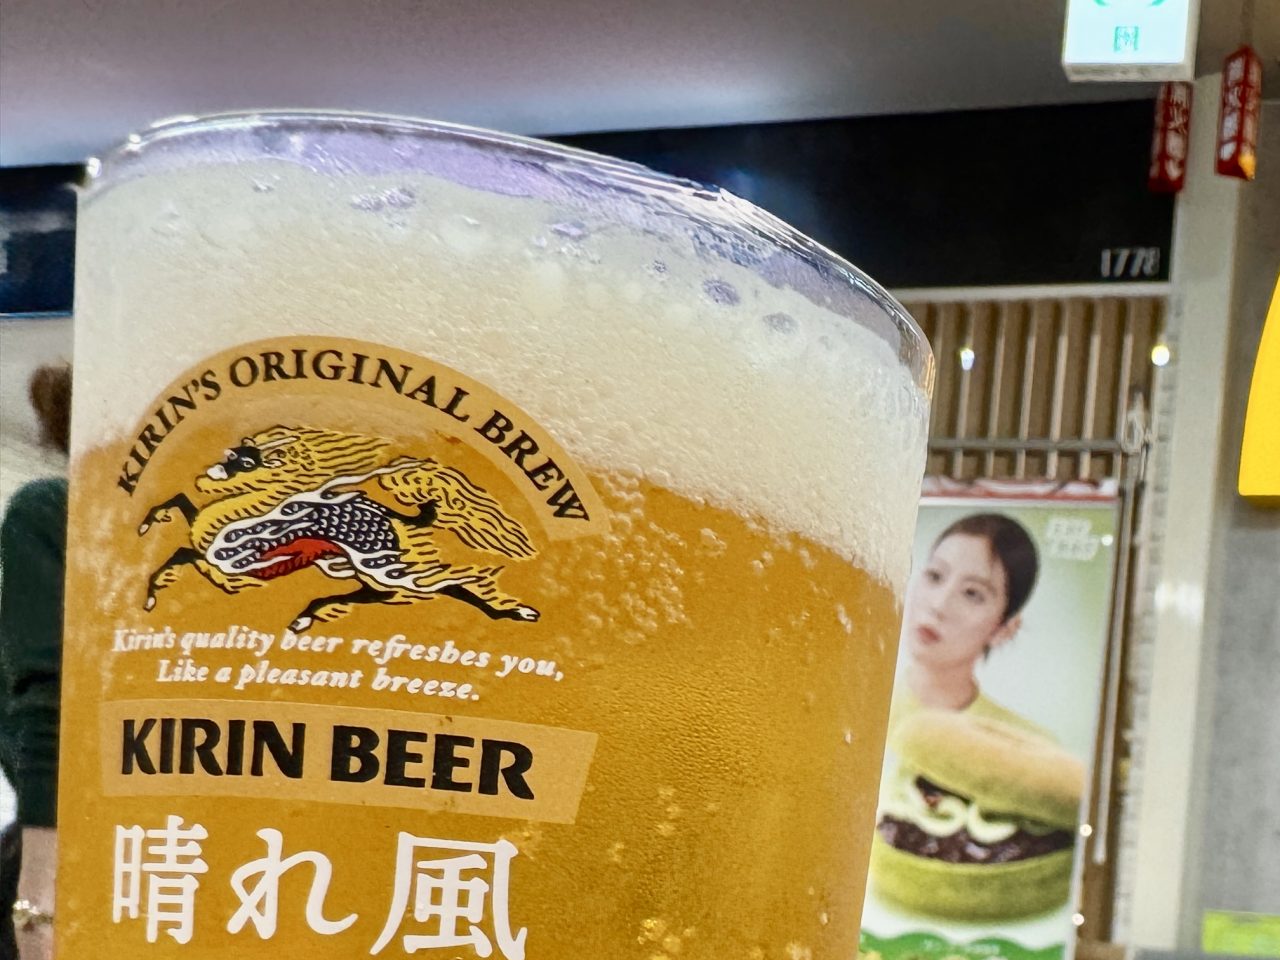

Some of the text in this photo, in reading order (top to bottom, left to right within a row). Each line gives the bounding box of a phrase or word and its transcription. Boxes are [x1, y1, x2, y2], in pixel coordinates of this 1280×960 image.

[116, 349, 590, 521] KIRIN'S ORIGINAL BREW
[112, 625, 564, 682] Kirin's quality beer refreshes you,
[156, 659, 480, 701] Like a pleasant breeze.
[121, 717, 535, 800] KIRIN BEER
